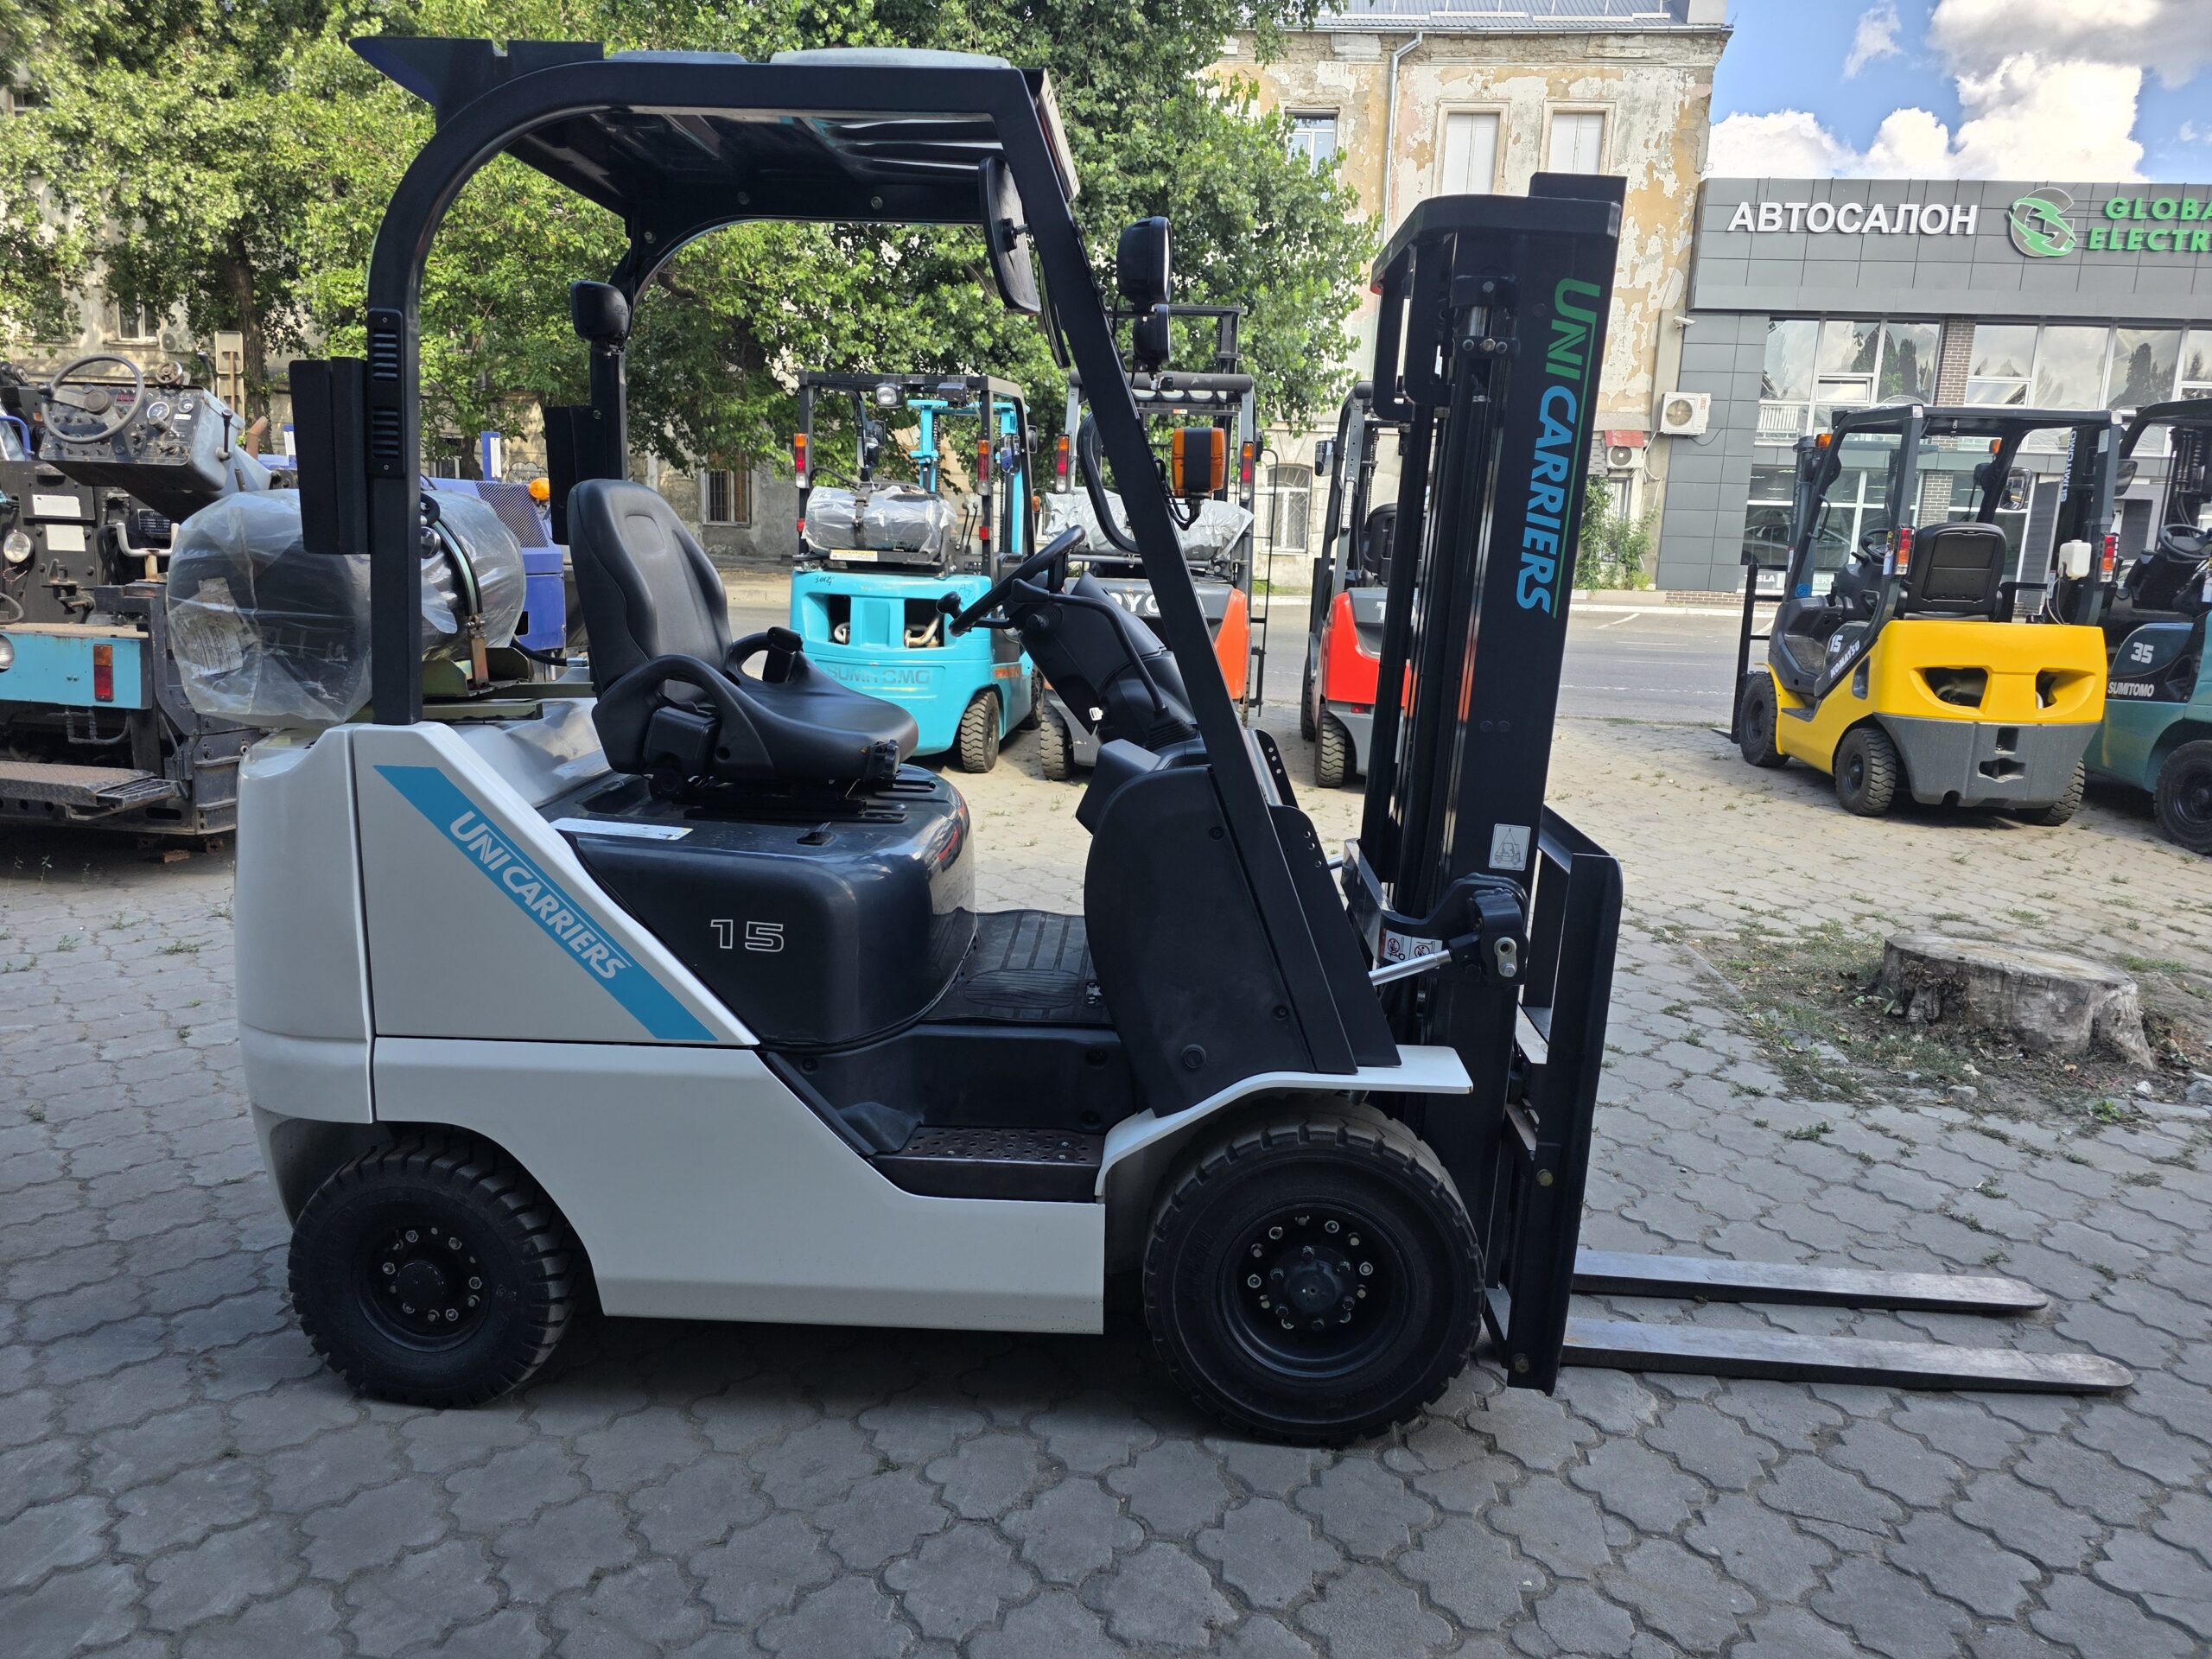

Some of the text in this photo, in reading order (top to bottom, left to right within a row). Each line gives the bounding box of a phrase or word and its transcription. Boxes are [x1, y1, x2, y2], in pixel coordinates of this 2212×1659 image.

[1727, 201, 1978, 235] АВТОСАЛОН
[2060, 430, 2077, 502] SUMITOMO
[1830, 634, 1843, 652] 15
[1830, 640, 1860, 678] KOMATSU
[2131, 641, 2154, 664] 35
[2108, 681, 2155, 697] SUMITOMO
[710, 918, 785, 953] 15
